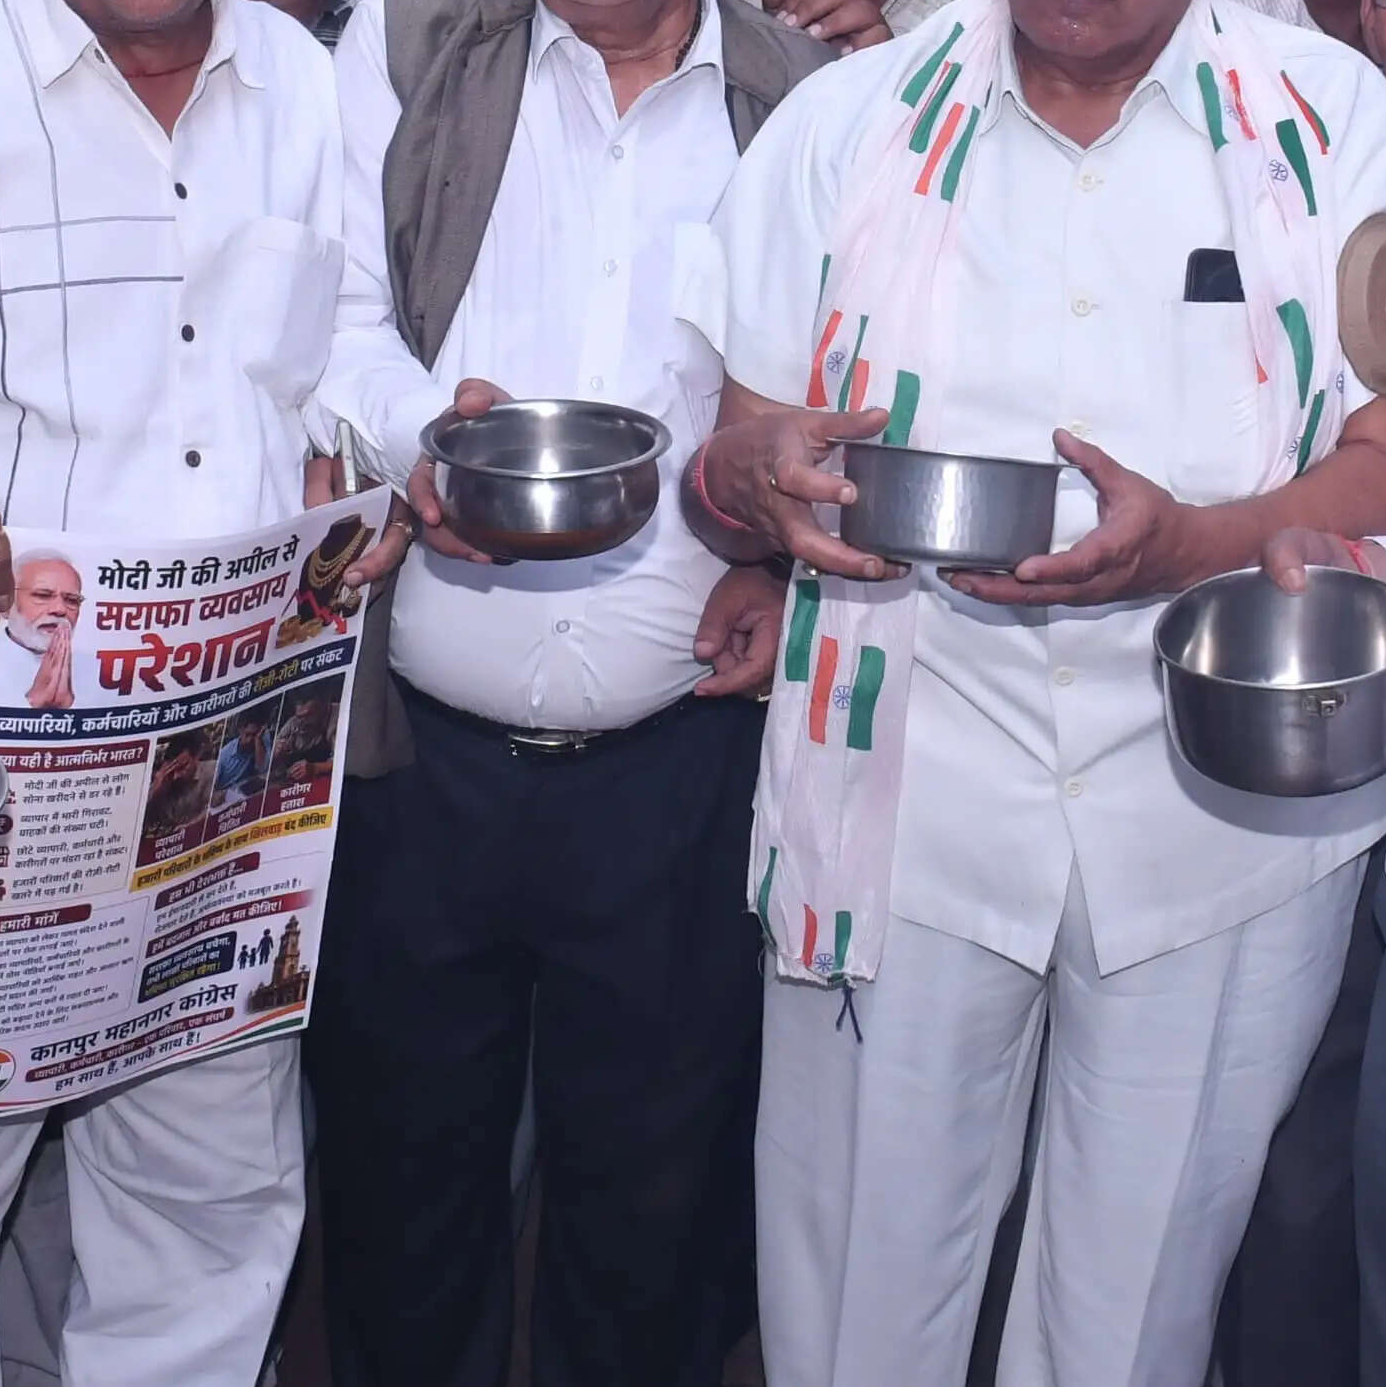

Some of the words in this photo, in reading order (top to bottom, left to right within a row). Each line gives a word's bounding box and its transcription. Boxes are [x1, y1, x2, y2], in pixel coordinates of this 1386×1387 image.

[97, 558, 153, 591] मोदी
[155, 559, 188, 590] जी
[191, 556, 223, 587] की
[223, 546, 281, 580] अपील
[282, 533, 301, 562] से
[95, 598, 196, 631] सराफा
[199, 570, 292, 622] व्यवसाय
[95, 616, 277, 699] परेशान
